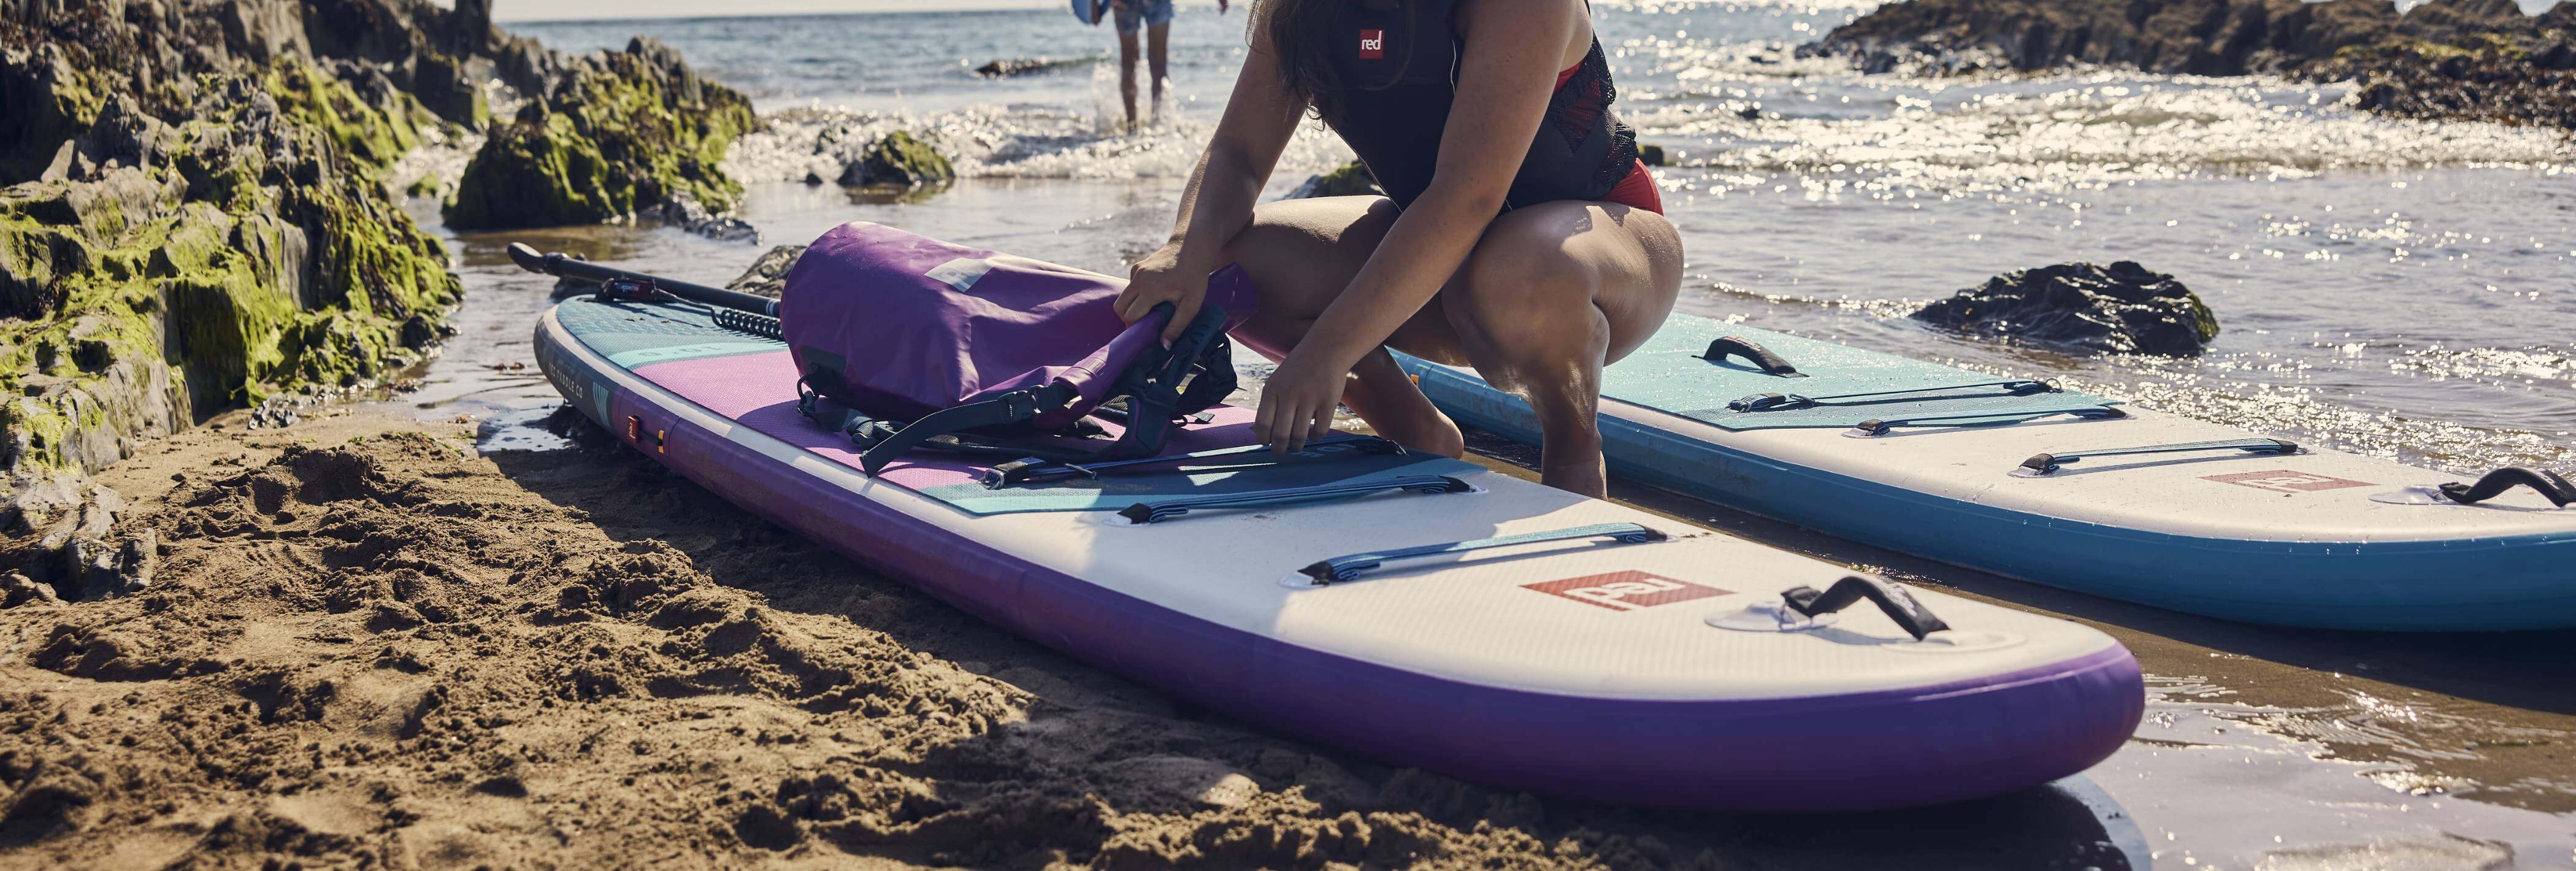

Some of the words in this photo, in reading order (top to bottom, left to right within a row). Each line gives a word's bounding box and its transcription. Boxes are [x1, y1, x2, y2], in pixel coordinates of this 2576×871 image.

[1361, 30, 1382, 50] red
[576, 385, 583, 399] CO
[2237, 475, 2335, 492] red
[1563, 578, 1688, 609] red
